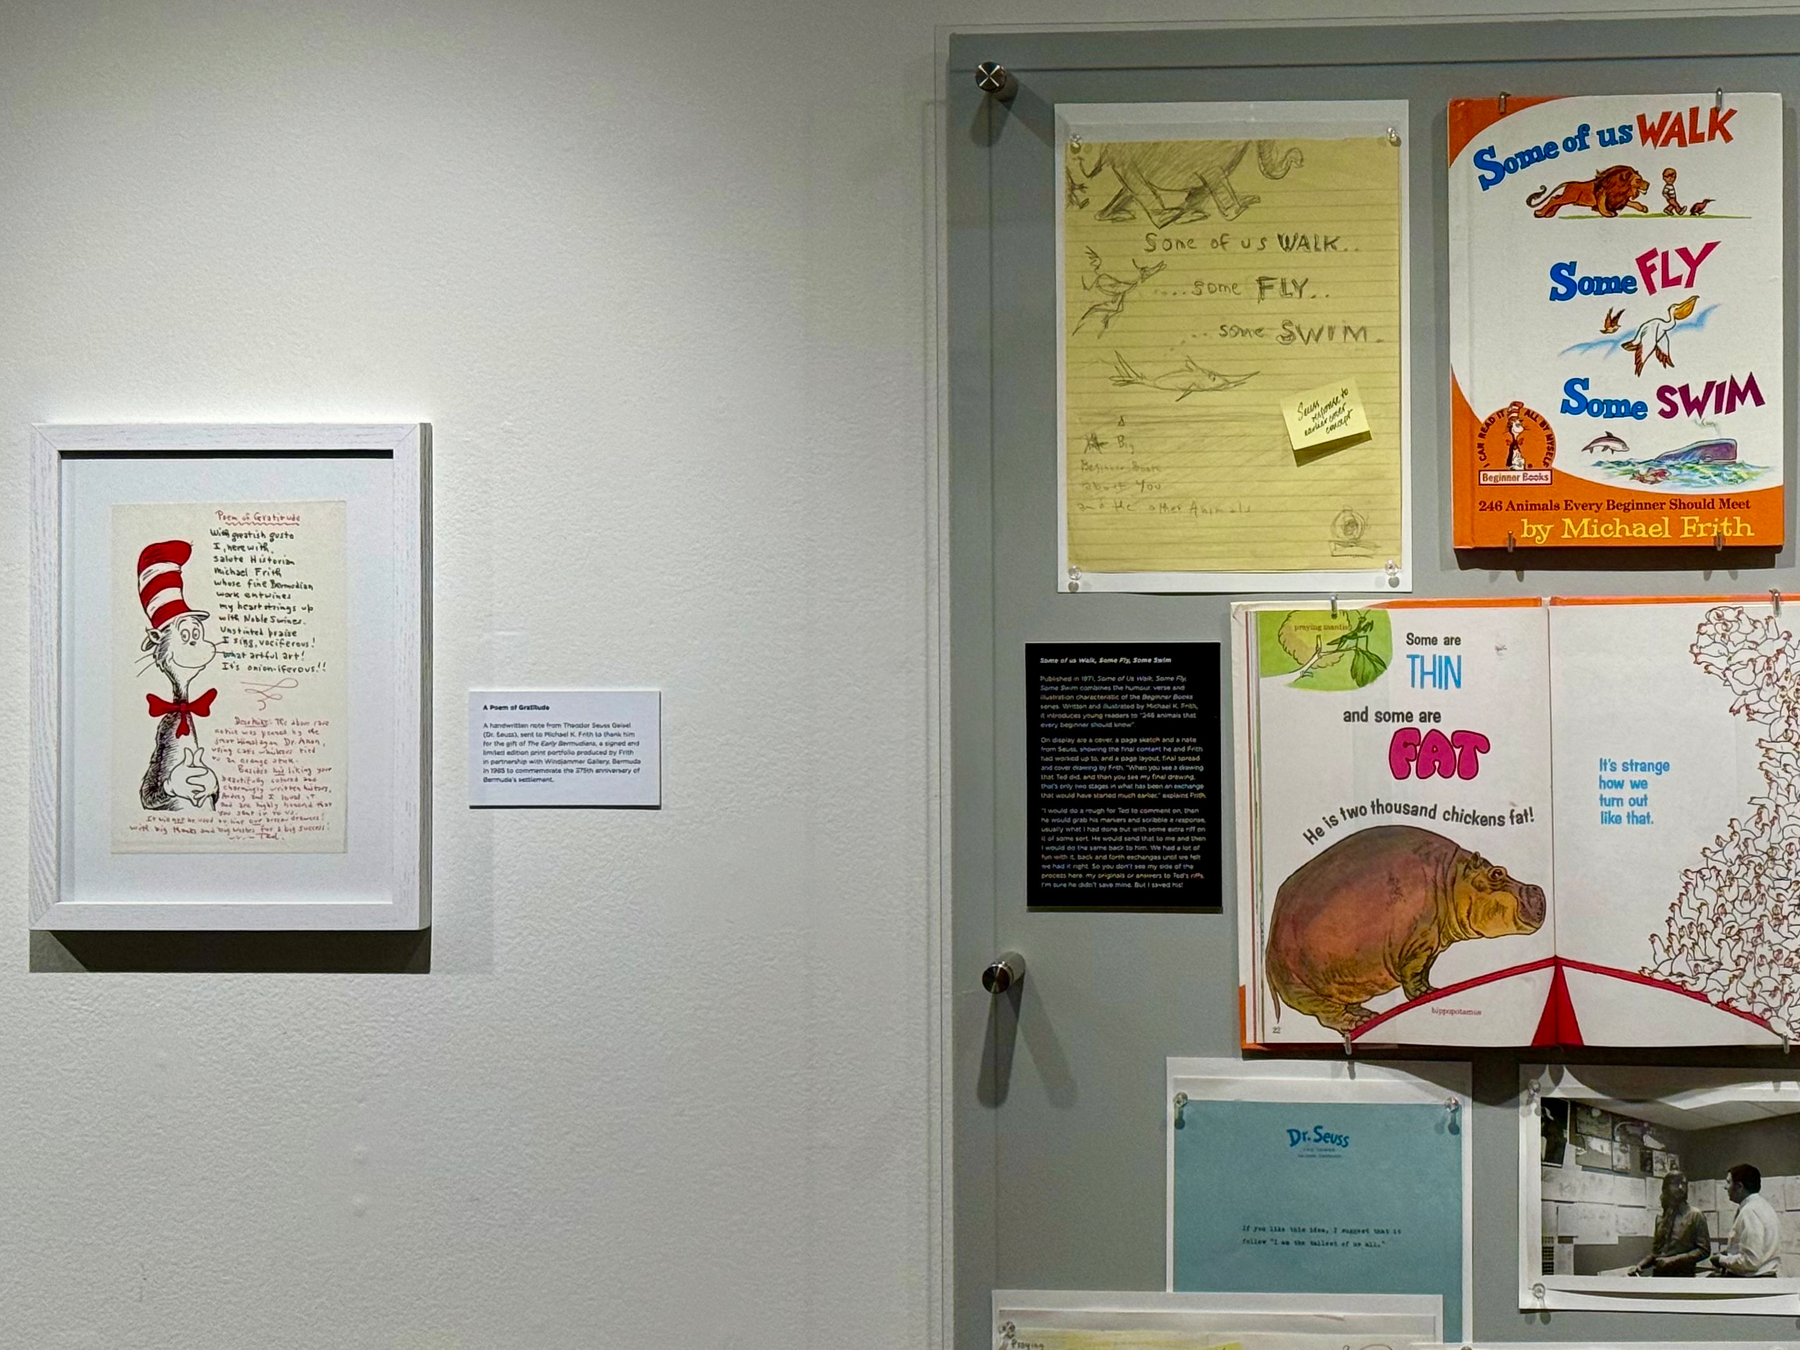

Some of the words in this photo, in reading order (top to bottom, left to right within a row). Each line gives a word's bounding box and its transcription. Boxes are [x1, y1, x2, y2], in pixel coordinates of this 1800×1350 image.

[1472, 139, 1560, 191] Some
[1562, 123, 1589, 152] of
[1596, 123, 1633, 148] us
[1636, 106, 1738, 149] WALK
[1145, 233, 1194, 252] Some
[1211, 233, 1229, 250] of
[1241, 236, 1267, 250] us
[1549, 261, 1638, 301] Some
[1635, 241, 1721, 296] FLY
[1560, 377, 1648, 420] Some
[1656, 371, 1766, 419] SWIM
[1311, 396, 1341, 422] response
[1340, 387, 1349, 399] to
[1304, 418, 1328, 436] earlier
[1329, 402, 1347, 422] cover
[1326, 409, 1353, 434] concept
[1496, 410, 1505, 419] IT
[1524, 409, 1539, 422] ALL
[1478, 416, 1496, 439] READ
[1539, 420, 1550, 431] BY
[1477, 443, 1487, 461] CAN
[1543, 434, 1555, 468] MYSELF
[1482, 473, 1520, 483] Beginner
[1522, 472, 1549, 481] Books
[1478, 500, 1503, 512] 246
[1505, 499, 1561, 512] Animals
[1563, 499, 1603, 513] Every
[1605, 499, 1666, 513] Beginner
[1669, 498, 1716, 511] Should
[1718, 498, 1751, 510] Meet
[215, 510, 237, 520] Poem
[254, 512, 300, 521] Gratitude
[269, 531, 294, 542] gusto
[1521, 518, 1554, 544] by
[1561, 517, 1673, 539] Michael
[1679, 515, 1755, 538] Frith
[255, 567, 282, 577] Frith
[214, 579, 241, 587] whose
[248, 579, 267, 588] fine
[270, 579, 313, 590] Bermudian
[244, 591, 291, 599] entwines
[219, 603, 233, 612] my
[301, 604, 314, 613] up
[244, 614, 268, 623] Noble
[222, 636, 229, 644] I
[268, 628, 297, 638] praise
[1406, 632, 1438, 646] Some
[1443, 635, 1461, 646] are
[249, 651, 278, 660] artful
[282, 651, 304, 661] art!
[222, 661, 239, 671] It's
[1406, 654, 1462, 690] THIN
[1343, 706, 1369, 723] and
[1374, 711, 1413, 723] some
[1419, 711, 1441, 723] are
[1388, 726, 1491, 781] FAT
[1599, 757, 1617, 772] It's
[1622, 758, 1671, 776] strange
[1599, 774, 1625, 790] how
[1629, 779, 1649, 790] we
[1599, 793, 1624, 807] turn
[1628, 793, 1649, 807] out
[1302, 825, 1326, 846] He
[1322, 814, 1339, 829] is
[1339, 804, 1368, 822] two
[1370, 798, 1437, 820] thousand
[1442, 805, 1506, 827] chickens
[1509, 806, 1535, 825] fat!
[1600, 810, 1622, 825] like
[1626, 810, 1654, 825] that.
[1431, 1007, 1482, 1016] hippopotamus
[1286, 1128, 1311, 1147] Dr.
[1313, 1125, 1350, 1148] Seuss
